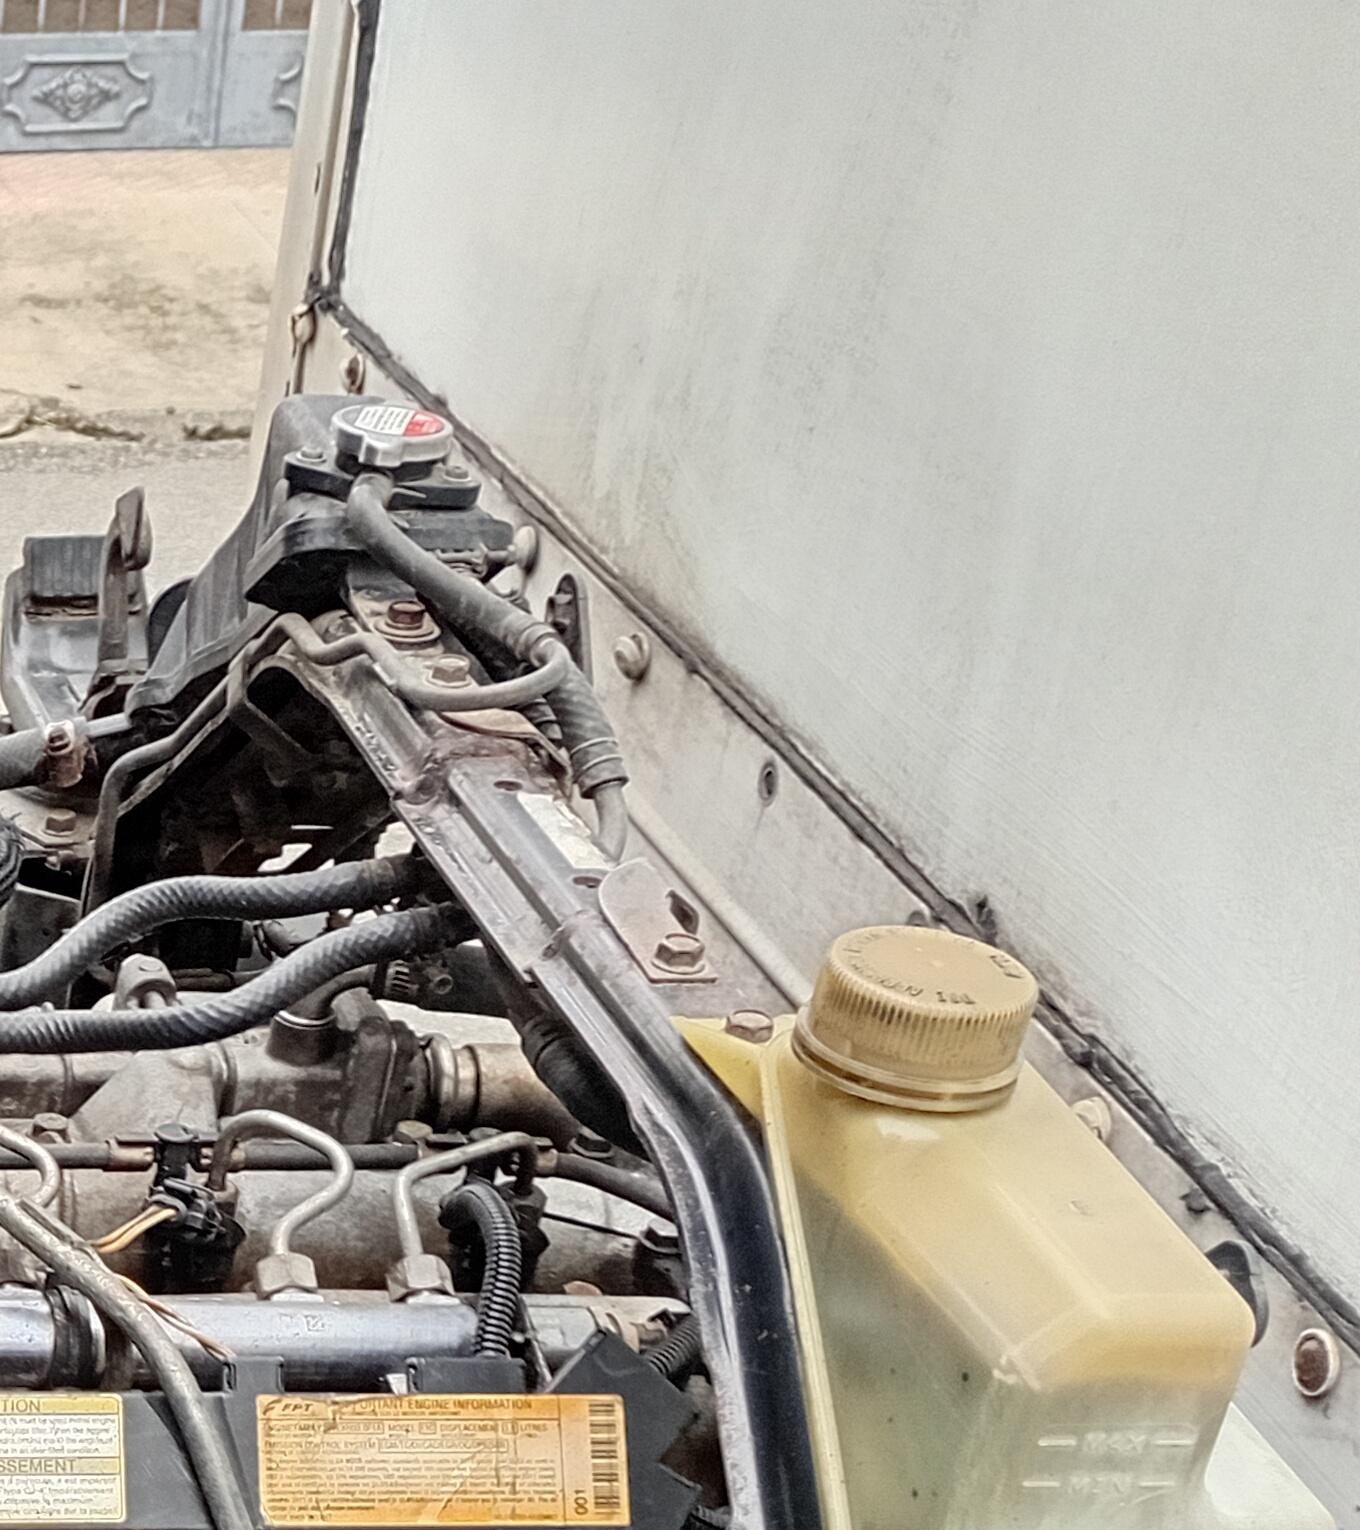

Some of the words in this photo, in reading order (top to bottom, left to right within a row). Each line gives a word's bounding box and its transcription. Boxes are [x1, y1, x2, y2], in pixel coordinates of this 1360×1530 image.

[281, 1402, 314, 1412] FPT
[407, 1399, 450, 1409] ENGINE
[453, 1398, 532, 1409] INFORMATION
